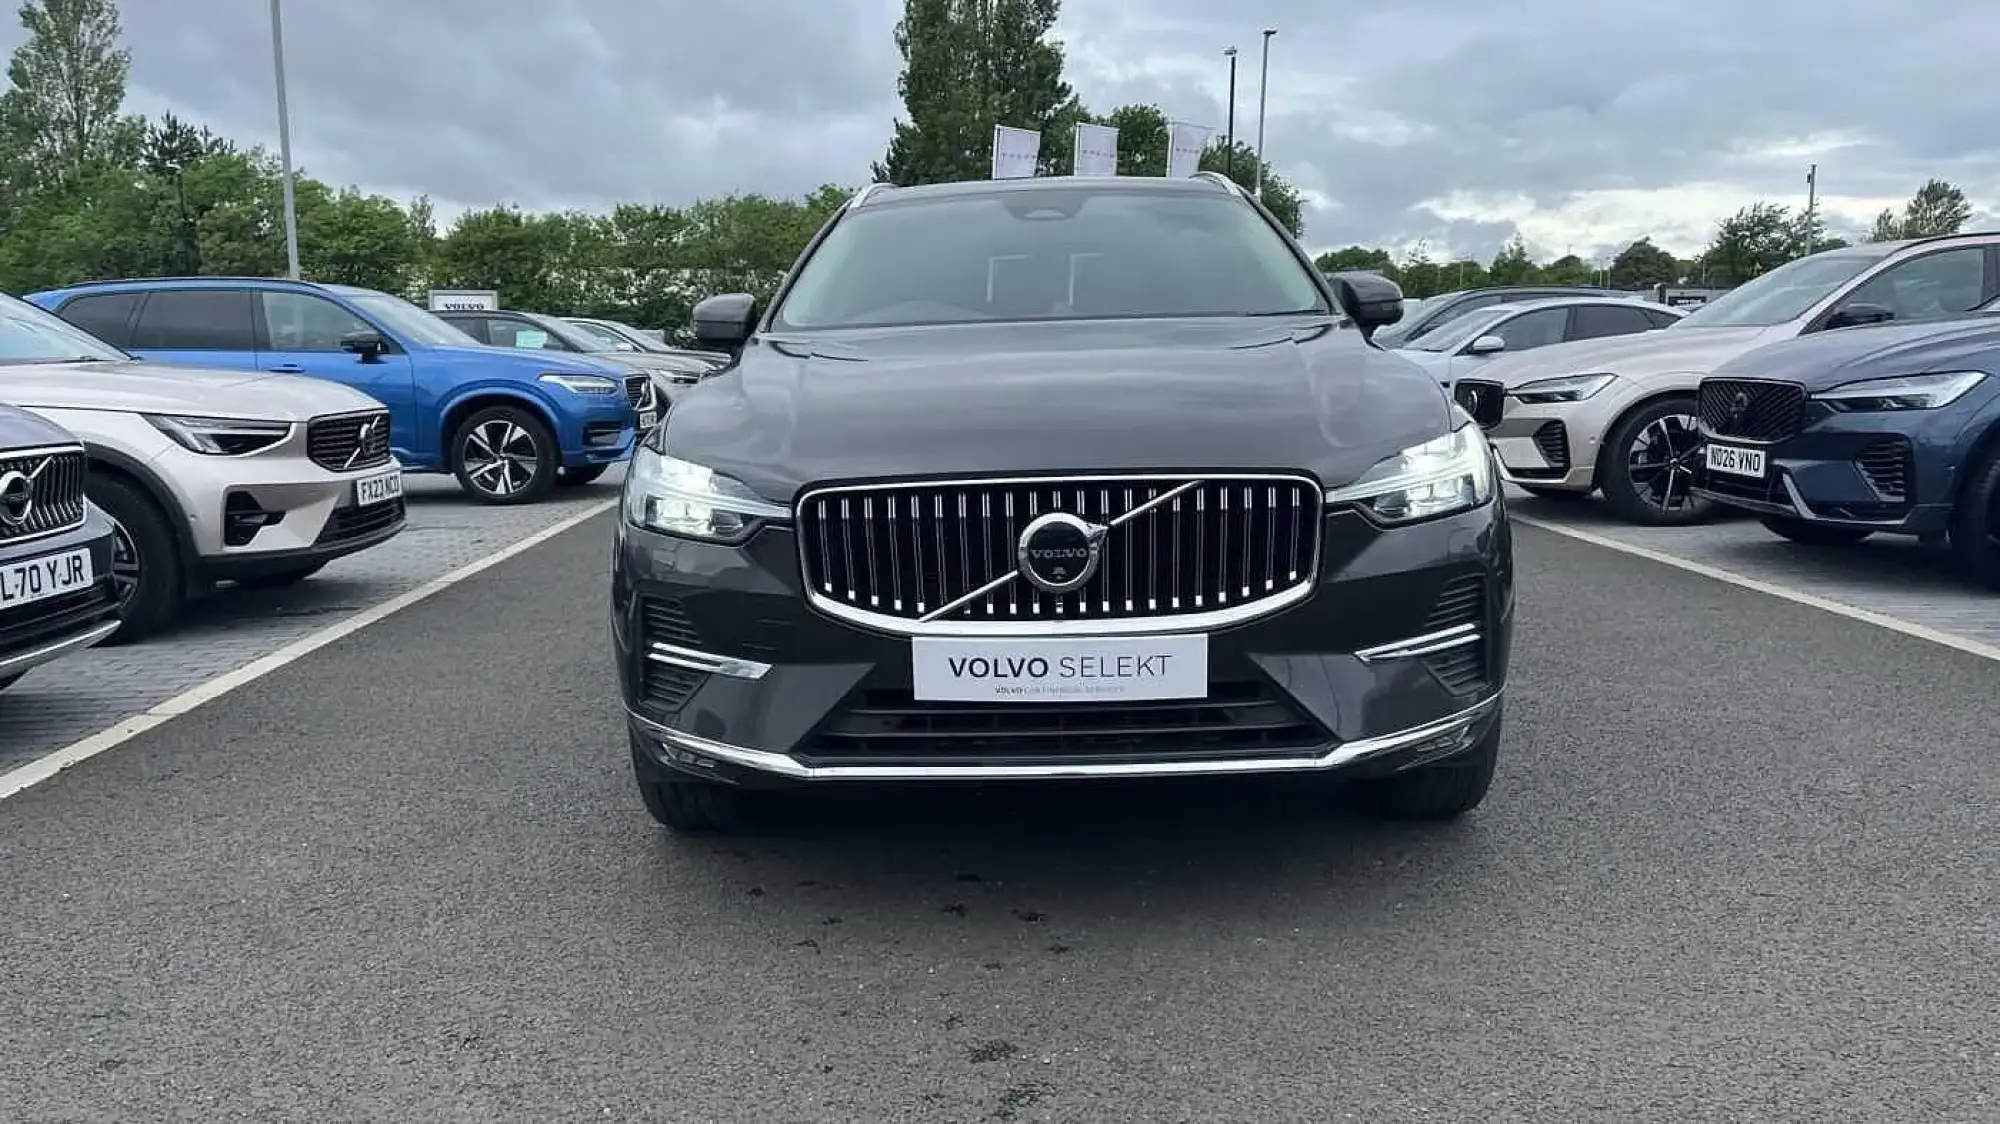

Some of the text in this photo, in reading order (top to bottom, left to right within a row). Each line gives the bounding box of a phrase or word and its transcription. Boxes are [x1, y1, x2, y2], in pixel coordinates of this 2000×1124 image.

[1029, 548, 1087, 558] VOLVO
[46, 555, 84, 589] YJR
[948, 655, 1172, 678] VOLVO SELEKT
